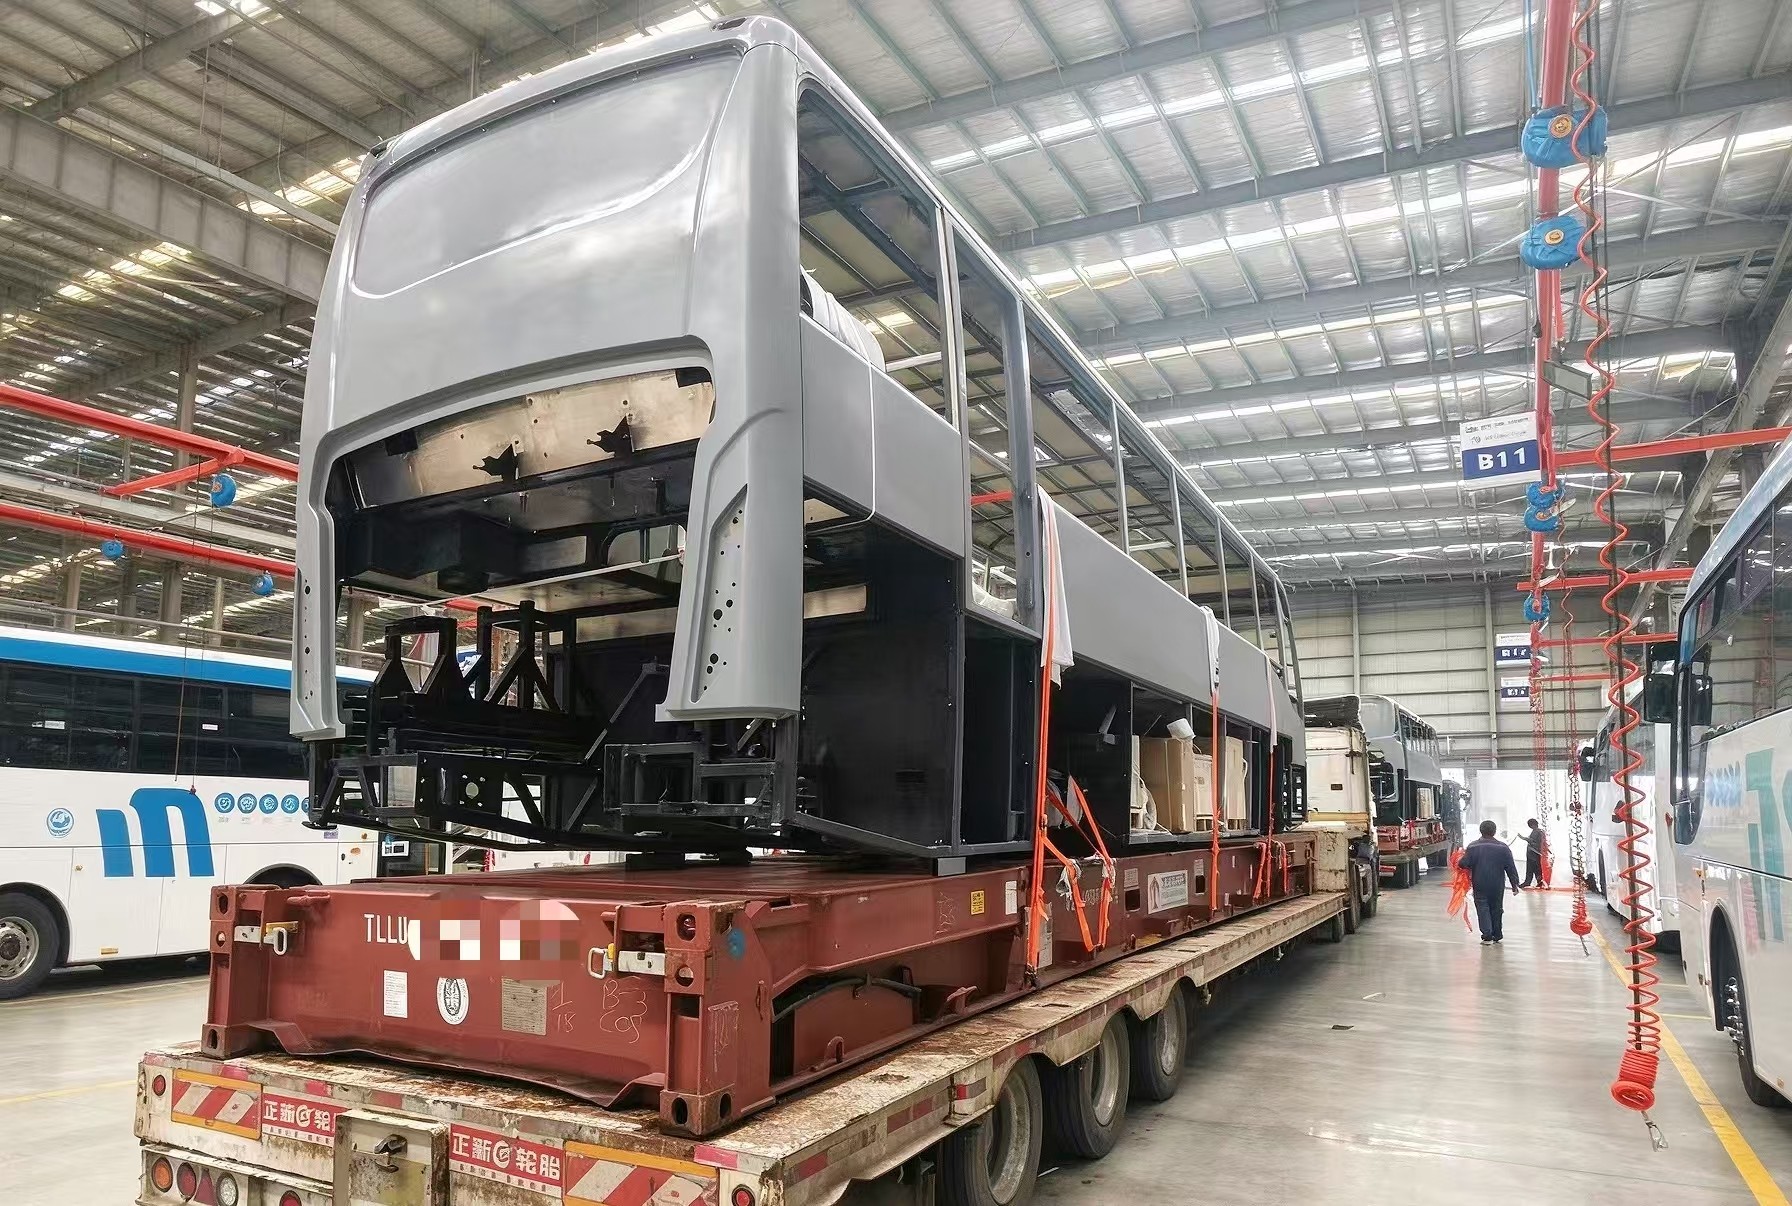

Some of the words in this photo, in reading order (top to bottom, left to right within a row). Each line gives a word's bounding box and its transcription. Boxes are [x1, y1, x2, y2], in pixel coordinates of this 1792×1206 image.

[1478, 447, 1526, 470] B11
[363, 913, 408, 945] TLLU
[452, 1132, 493, 1163] 正新
[515, 1146, 561, 1181] 轮胎
